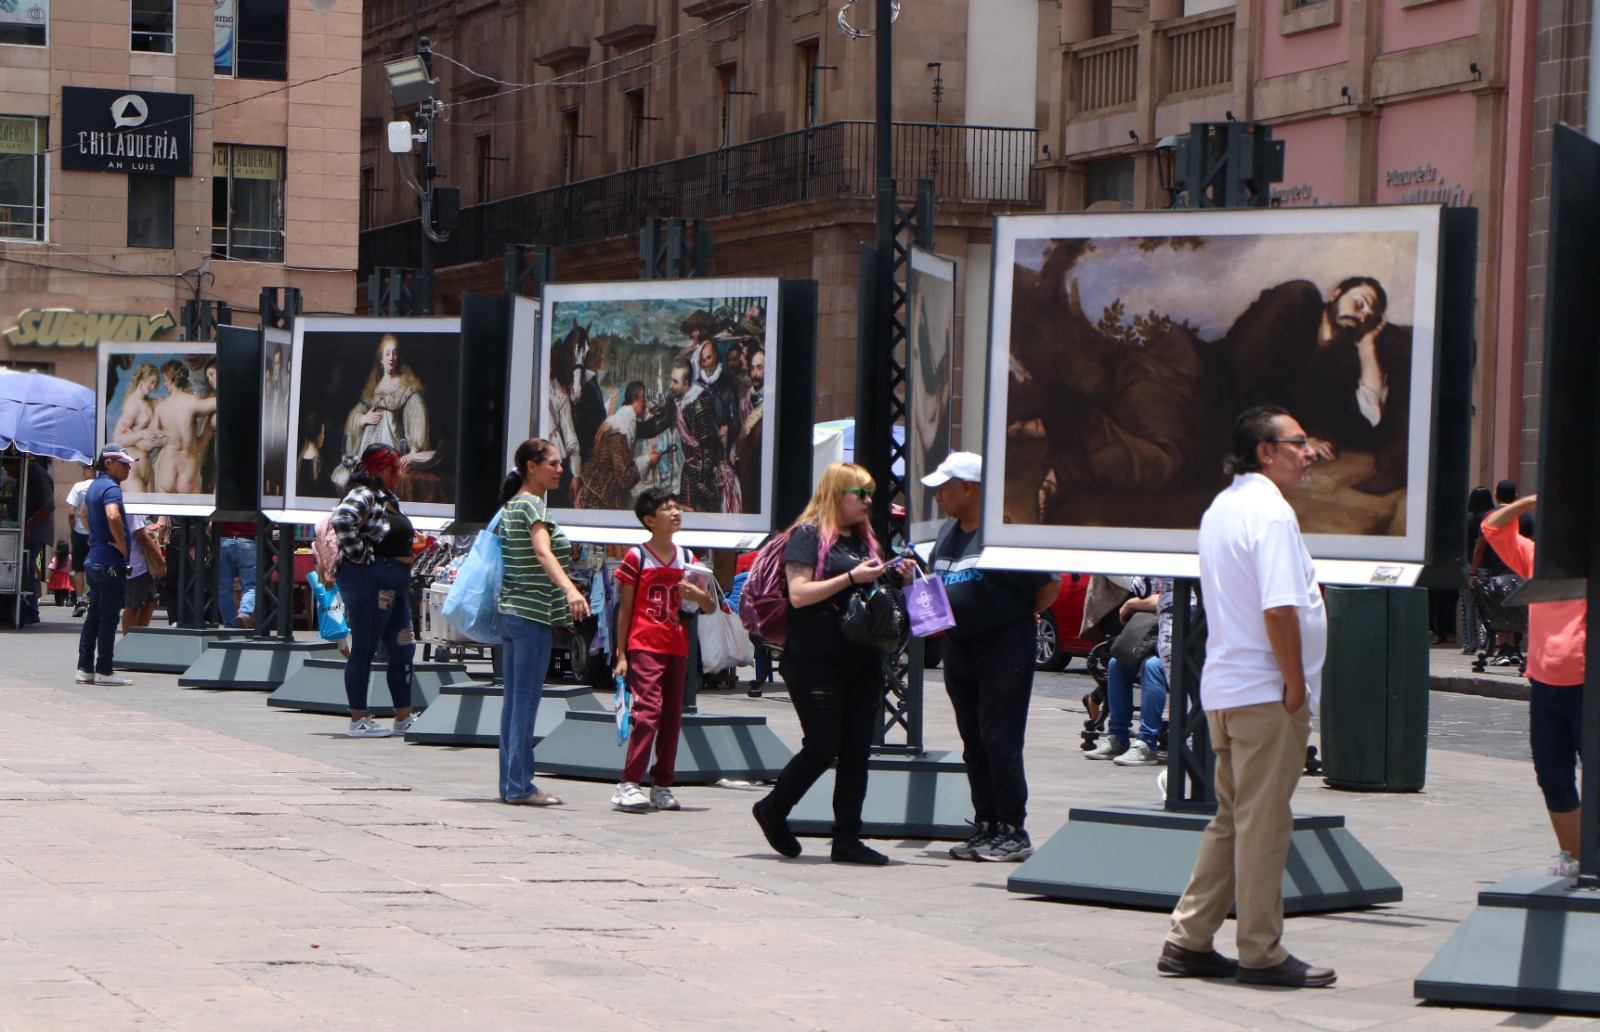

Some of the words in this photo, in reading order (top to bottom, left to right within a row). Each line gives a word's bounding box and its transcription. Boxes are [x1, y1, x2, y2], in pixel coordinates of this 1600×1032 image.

[132, 162, 155, 171] LUIS
[3, 308, 177, 348] SUBWAY
[944, 569, 983, 587] TEXANS
